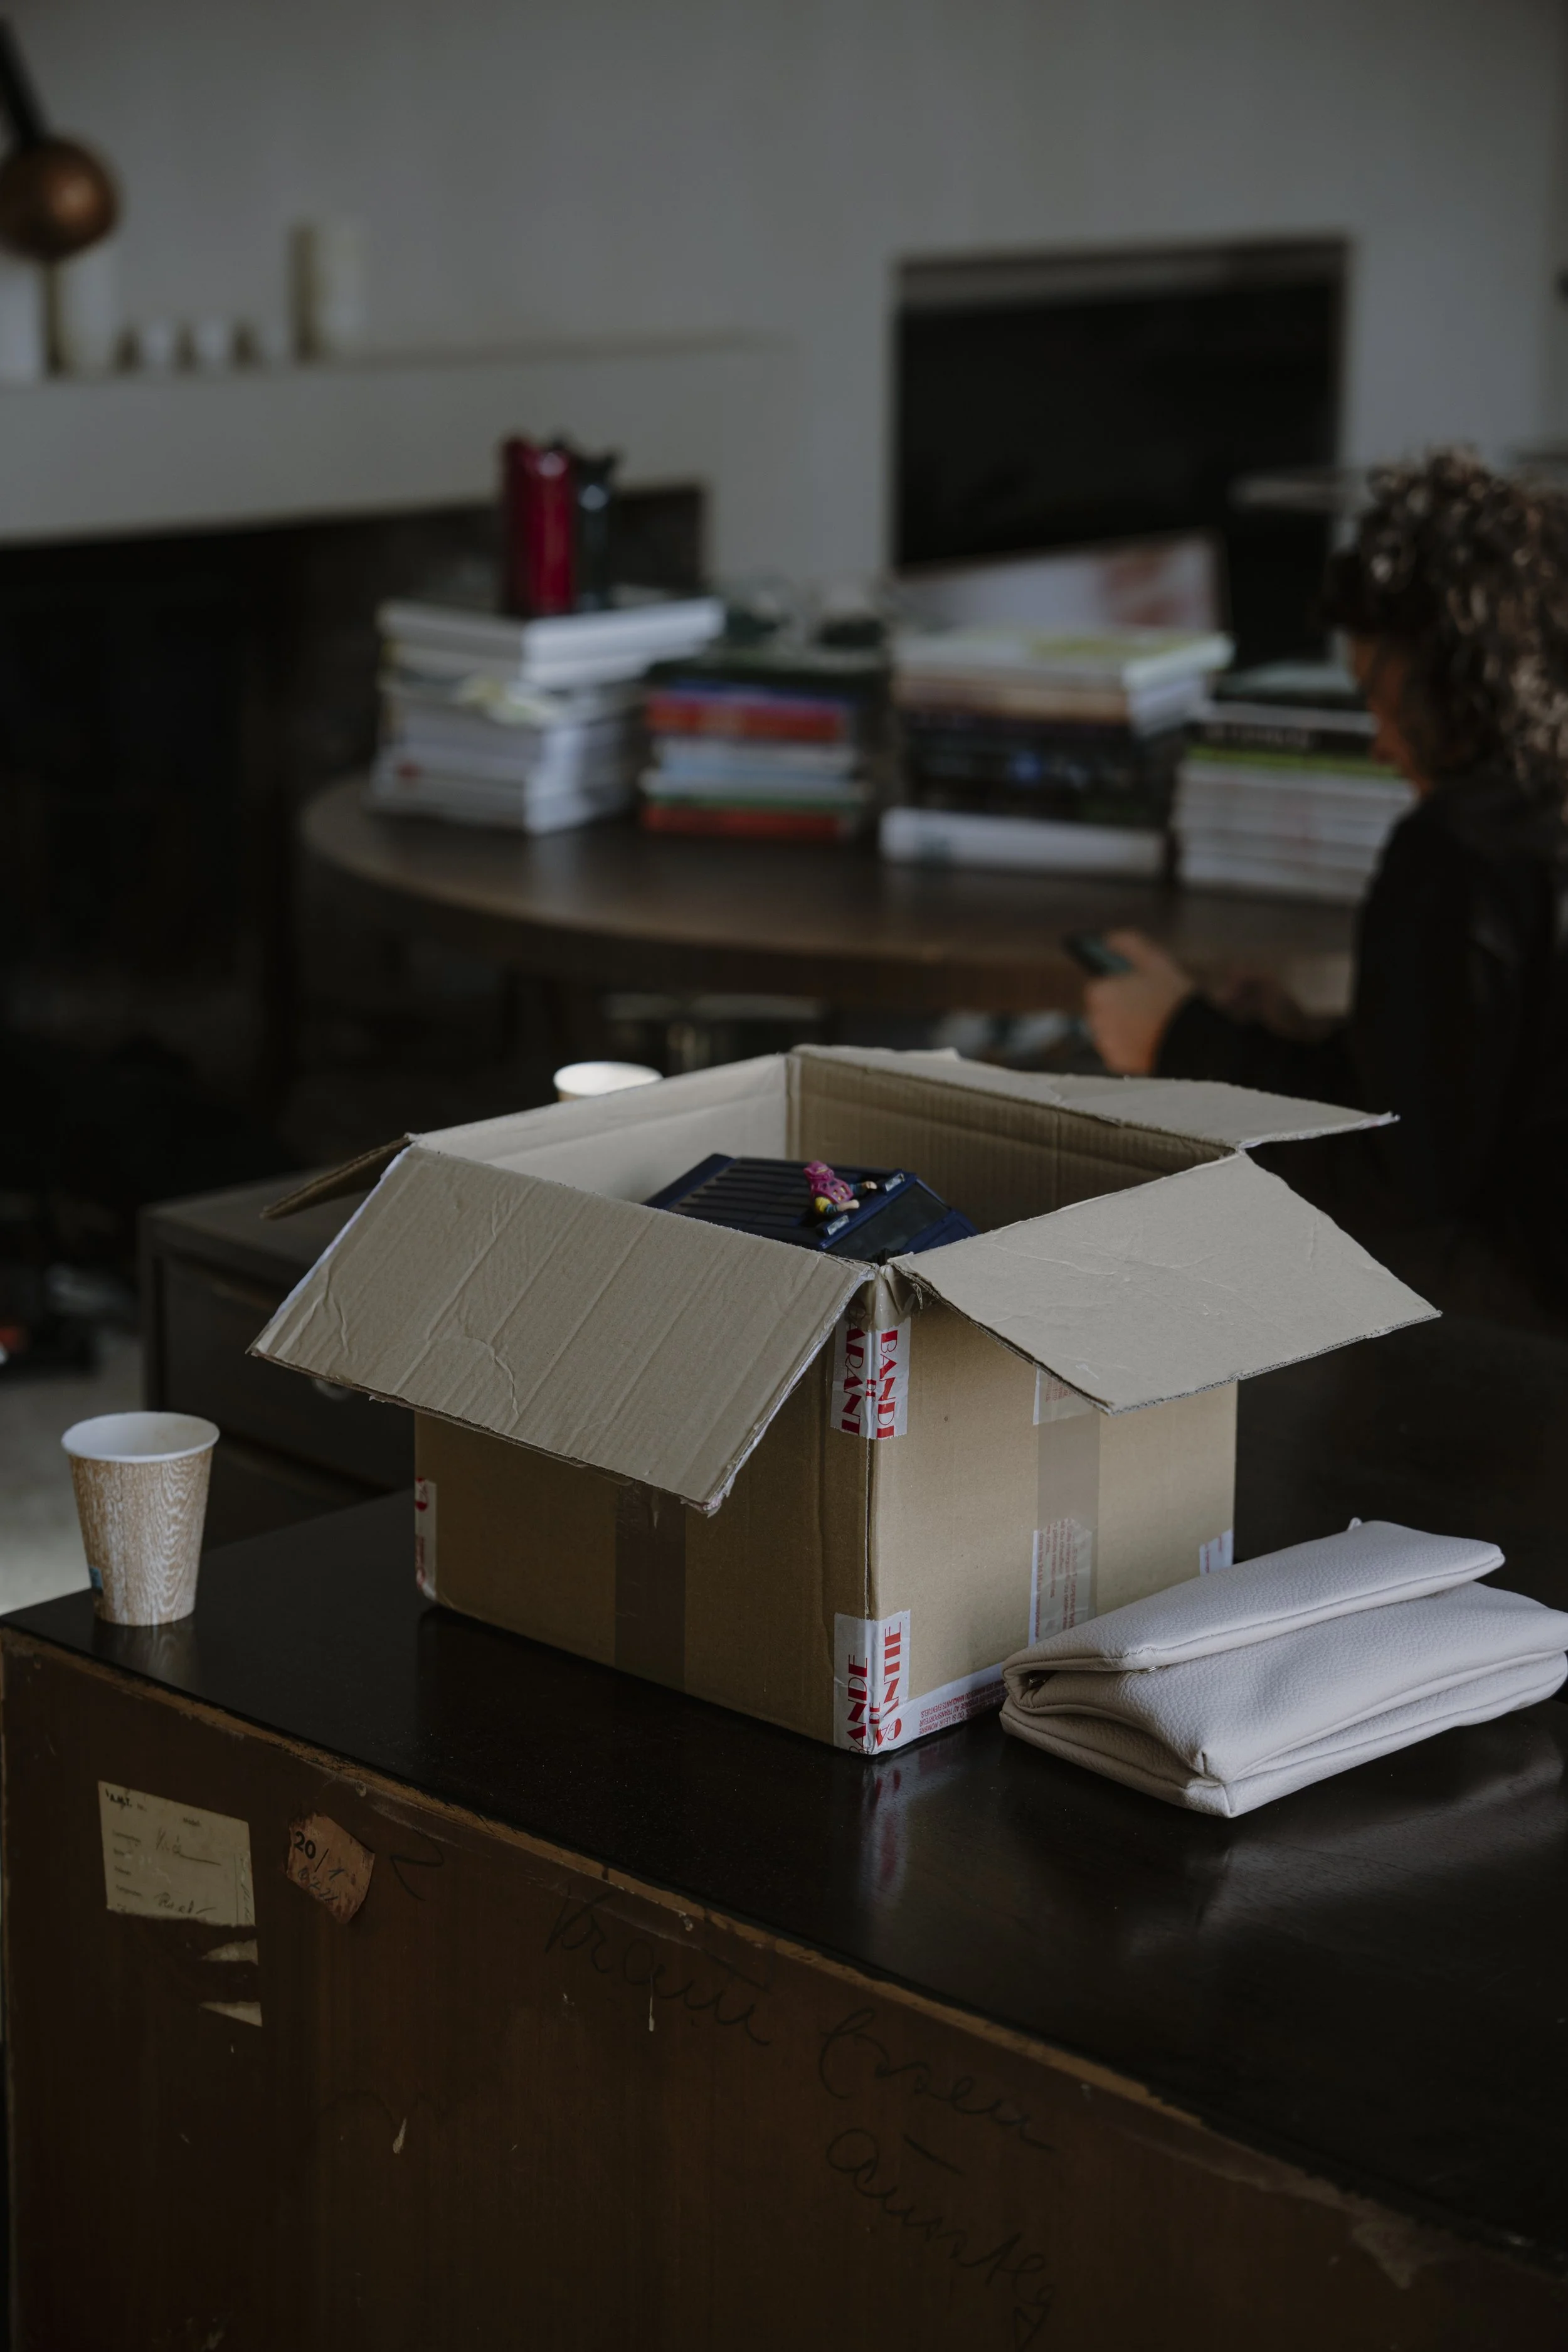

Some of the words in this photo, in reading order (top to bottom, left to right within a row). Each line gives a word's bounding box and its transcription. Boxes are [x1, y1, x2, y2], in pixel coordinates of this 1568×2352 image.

[866, 1379, 877, 1402] DE
[942, 1693, 965, 1709] MANQUANTS
[869, 1702, 880, 1724] DE
[919, 1707, 953, 1727] TRANSPORTEUR
[953, 1705, 960, 1714] AU
[918, 1723, 938, 1735] NOMBRE
[939, 1718, 951, 1727] LEUR
